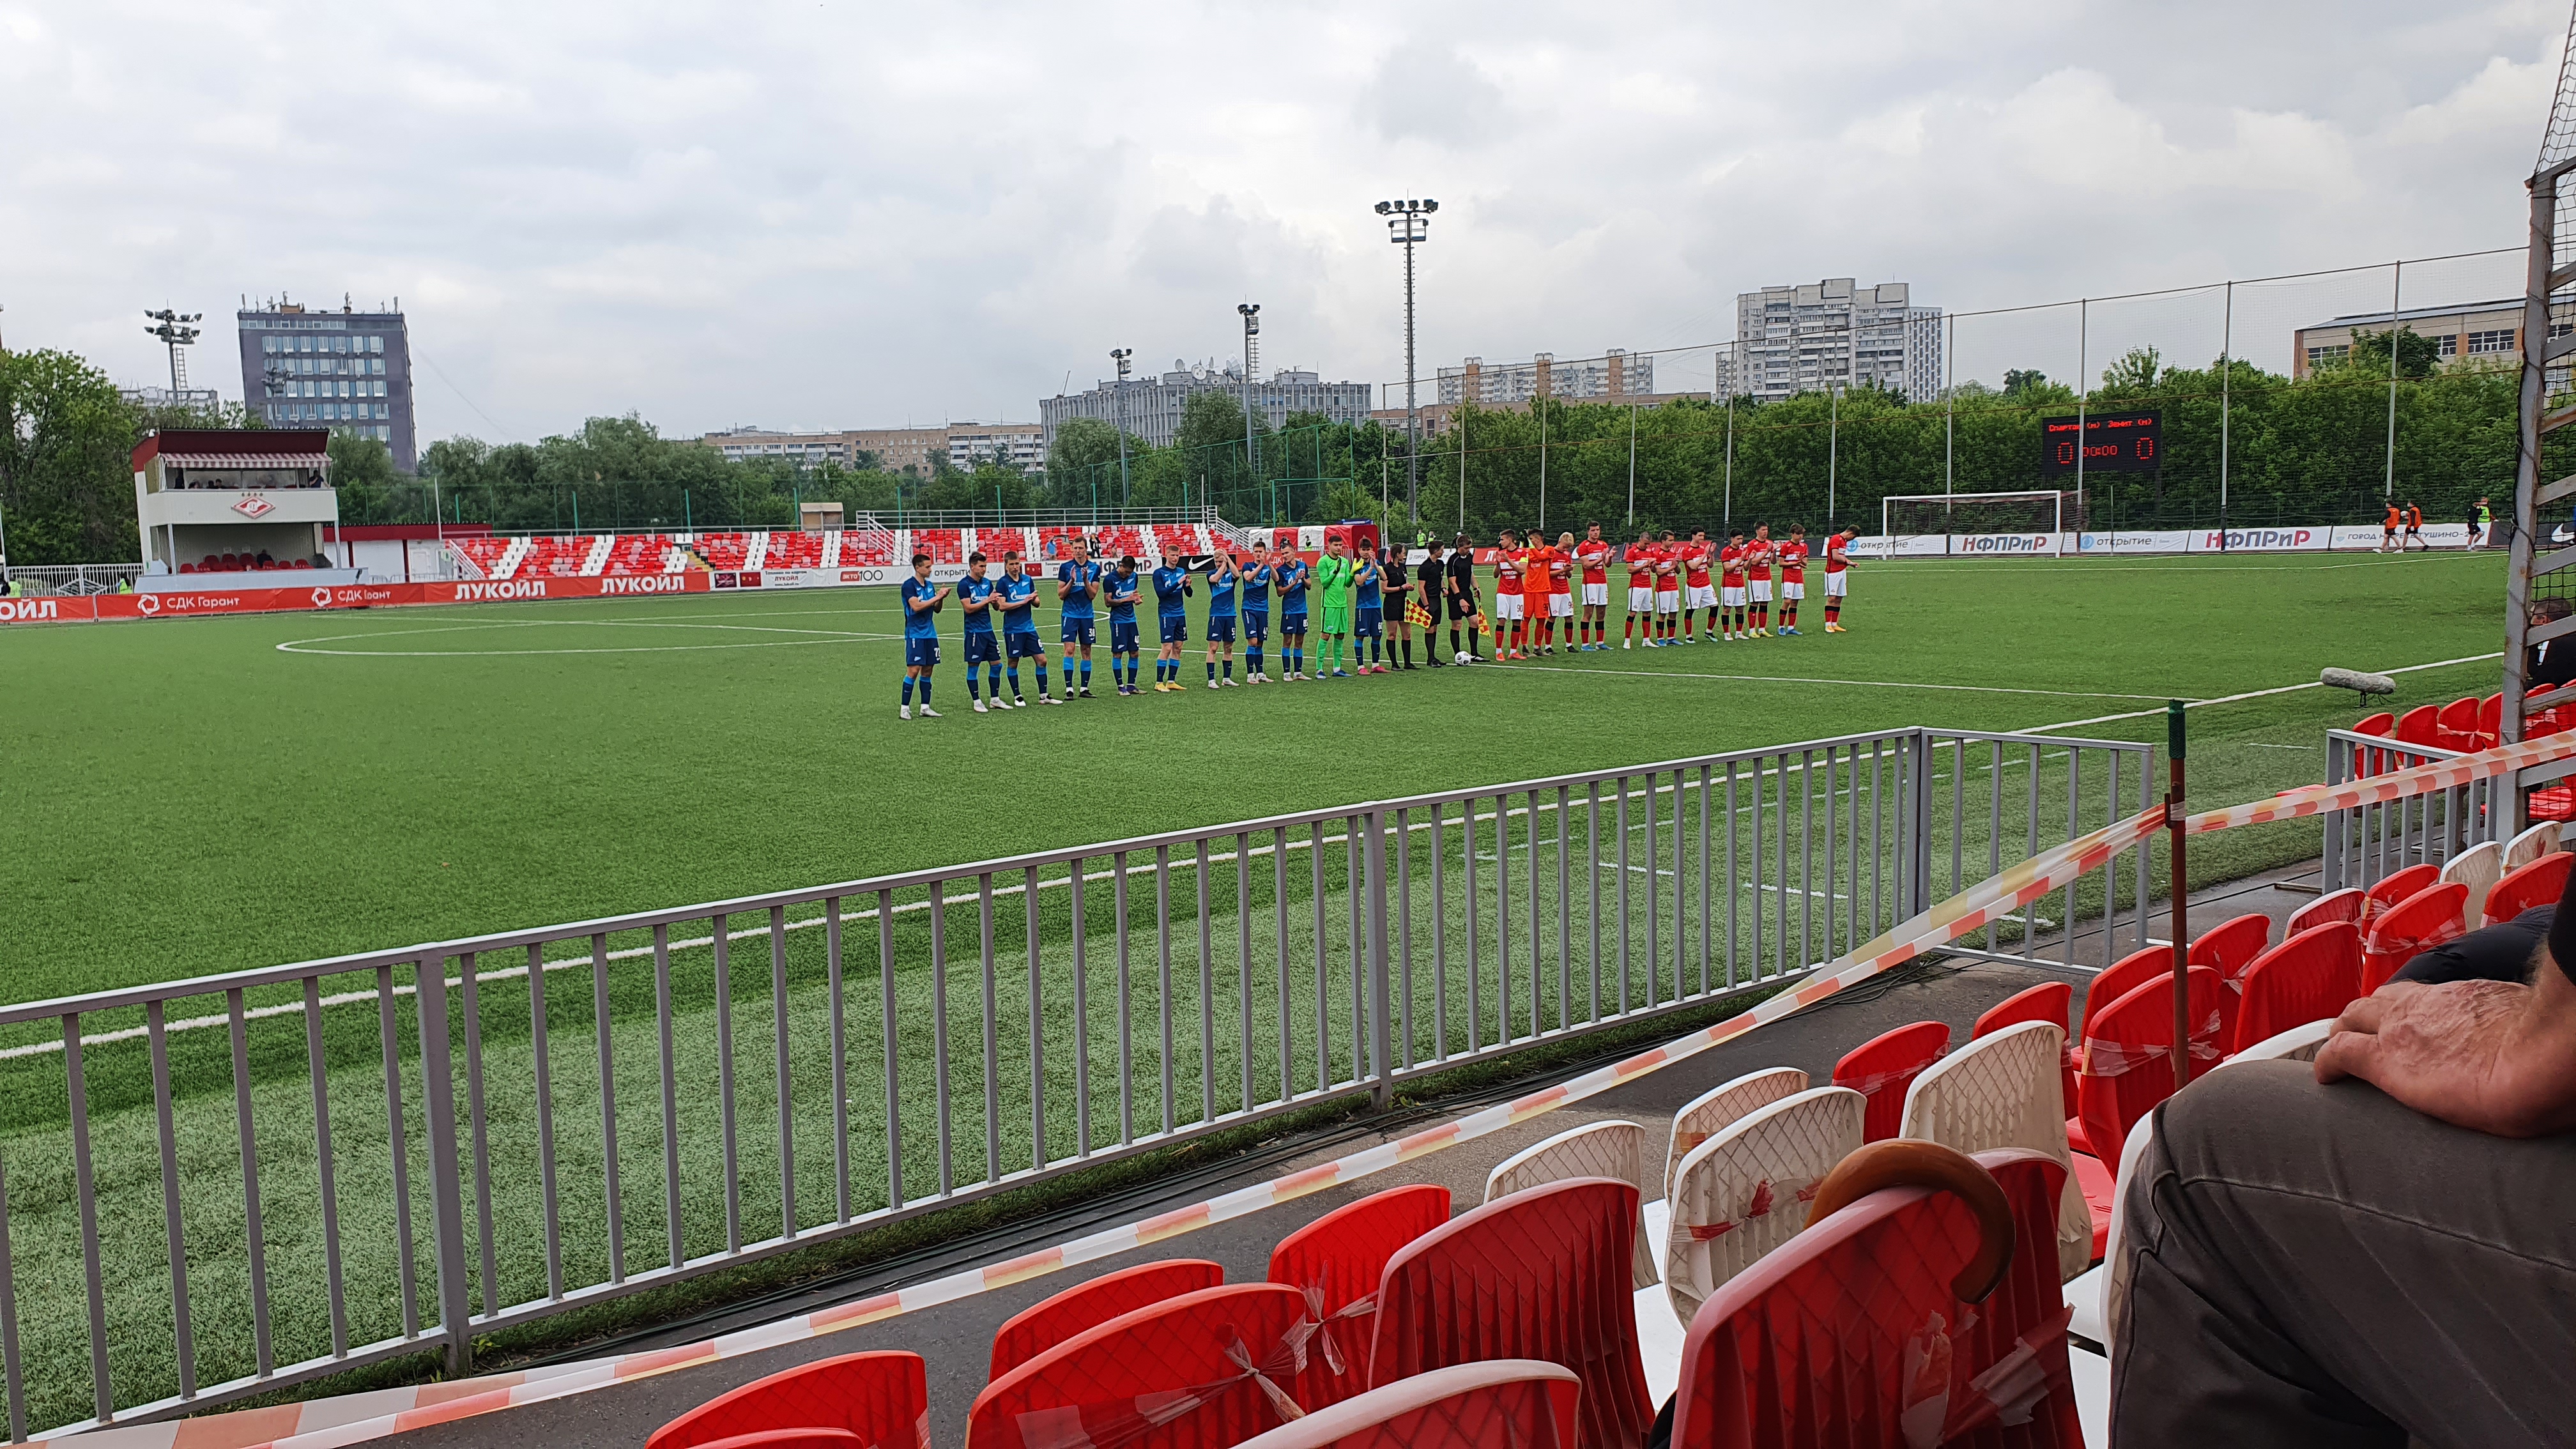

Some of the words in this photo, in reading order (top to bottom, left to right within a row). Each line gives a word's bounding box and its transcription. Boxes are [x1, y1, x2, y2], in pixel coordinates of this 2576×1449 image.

[1962, 537, 2047, 551] НФПРиР
[2097, 537, 2152, 547] открытие
[1271, 556, 1282, 565] ДК
[935, 569, 970, 578] открыти
[455, 579, 546, 601] ЛУКОЙЛ
[600, 574, 684, 594] ЛУКОЙЛ
[338, 589, 363, 602] СДК
[166, 597, 195, 610] СДК
[197, 596, 240, 608] Гарант
